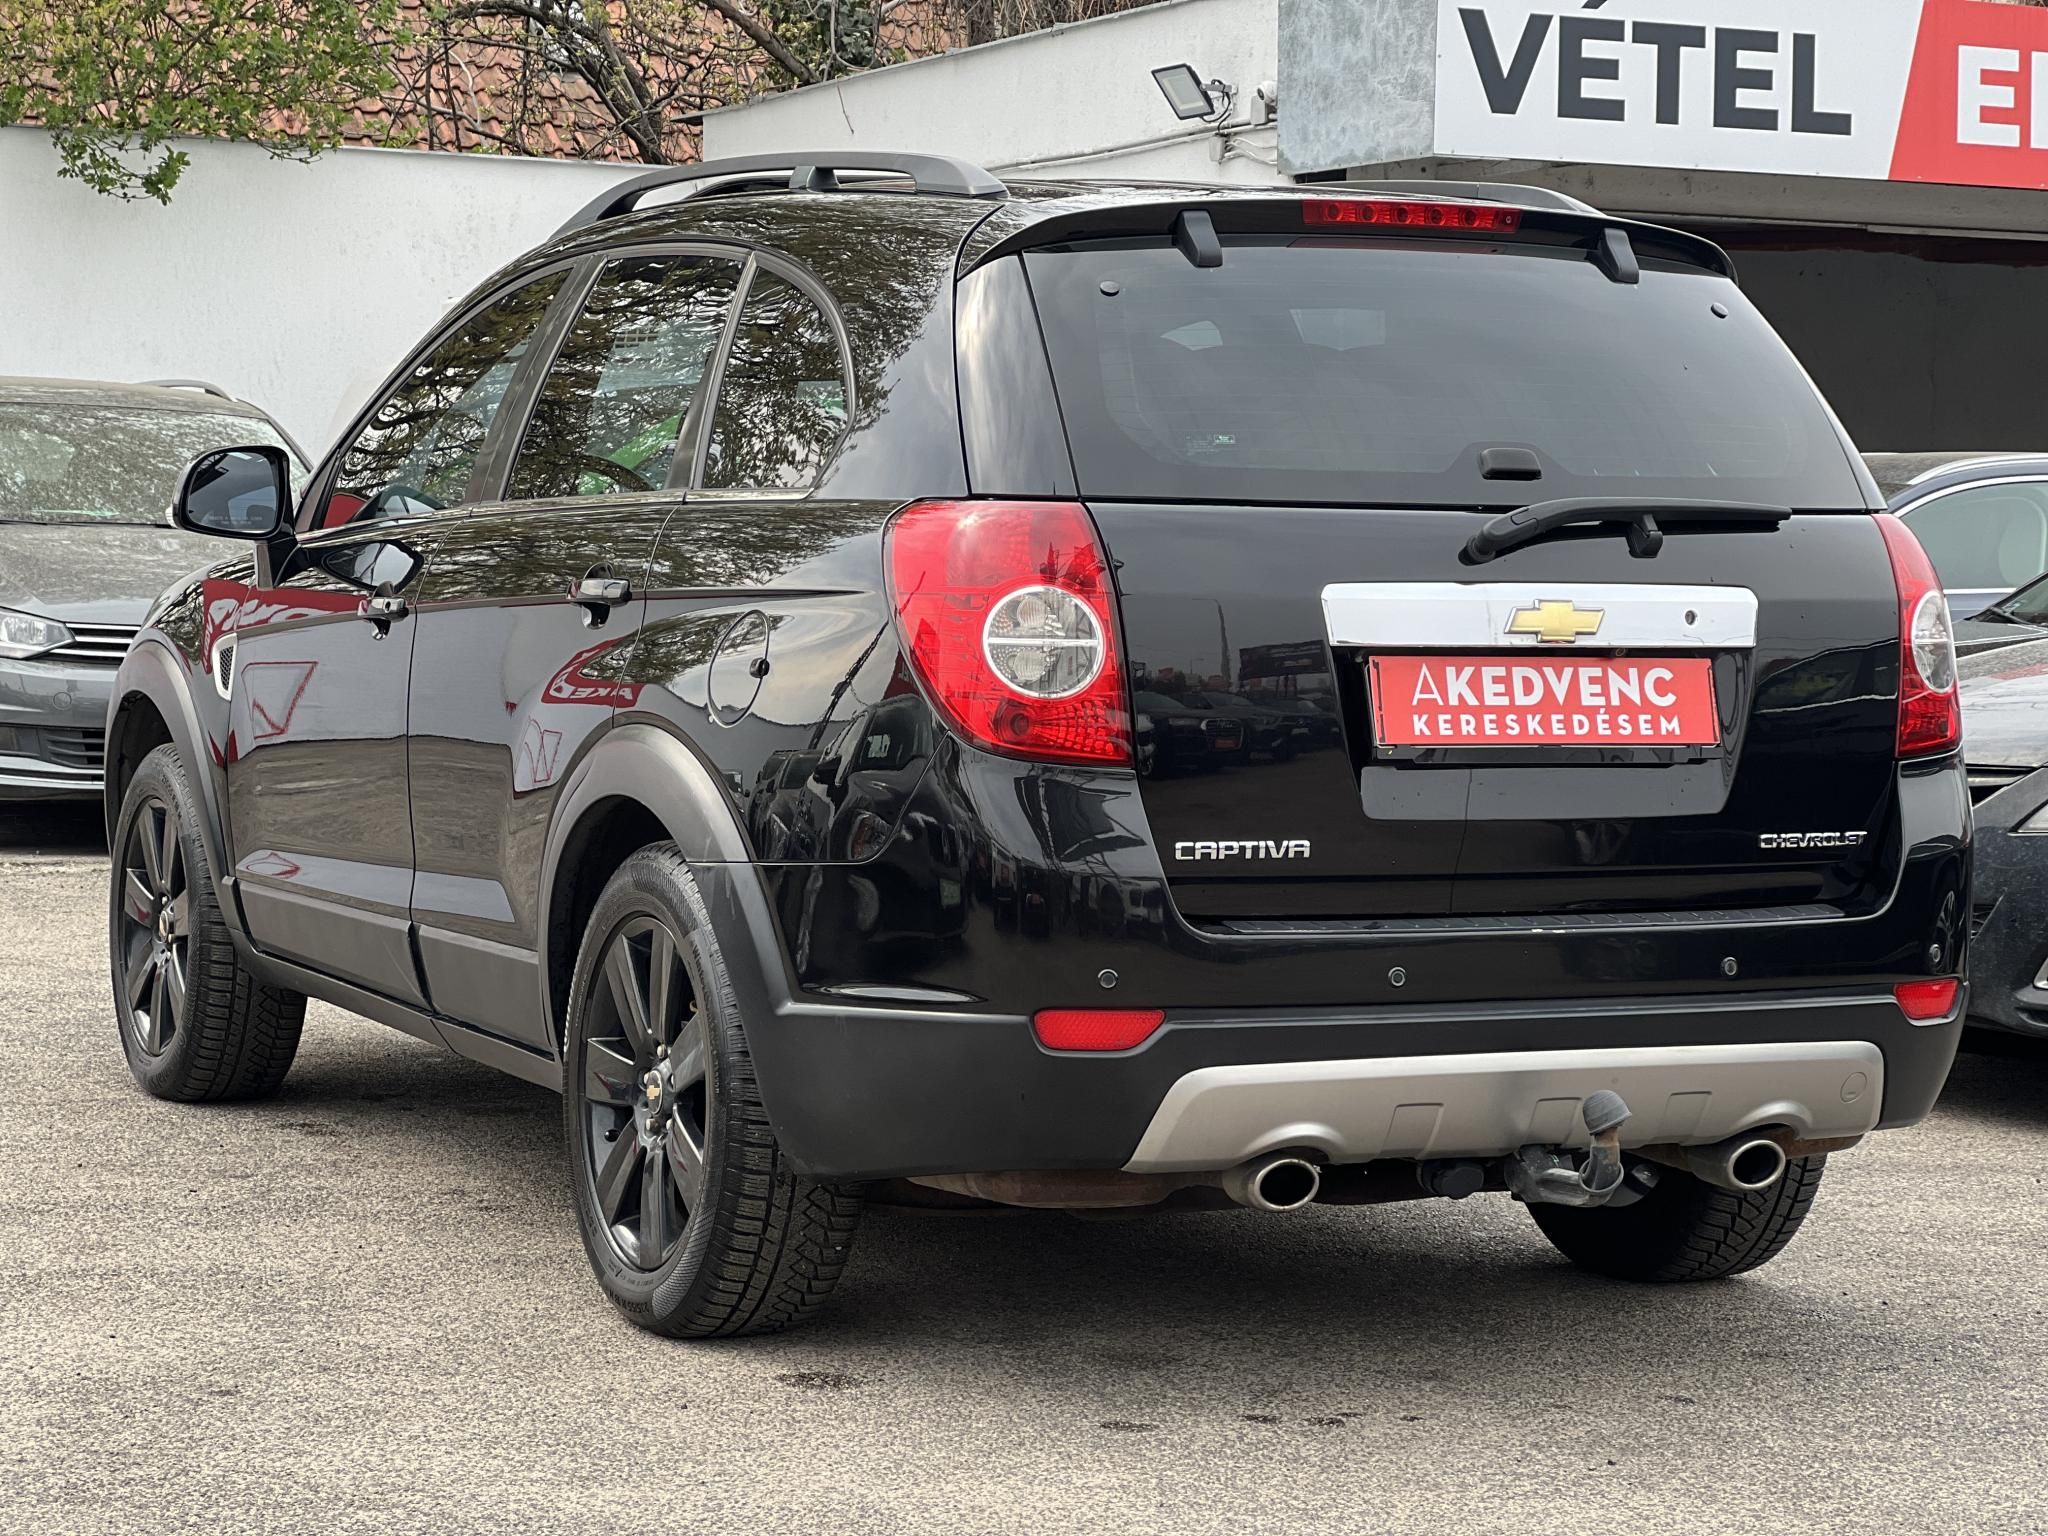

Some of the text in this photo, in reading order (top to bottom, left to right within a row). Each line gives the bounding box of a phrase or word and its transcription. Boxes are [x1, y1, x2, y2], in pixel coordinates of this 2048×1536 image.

[1459, 0, 1852, 136] VÉTEL
[1413, 708, 1681, 736] KERESKEDÉSEM
[1174, 840, 1311, 860] CAPTIVA
[1759, 831, 1868, 849] CHEVROLET
